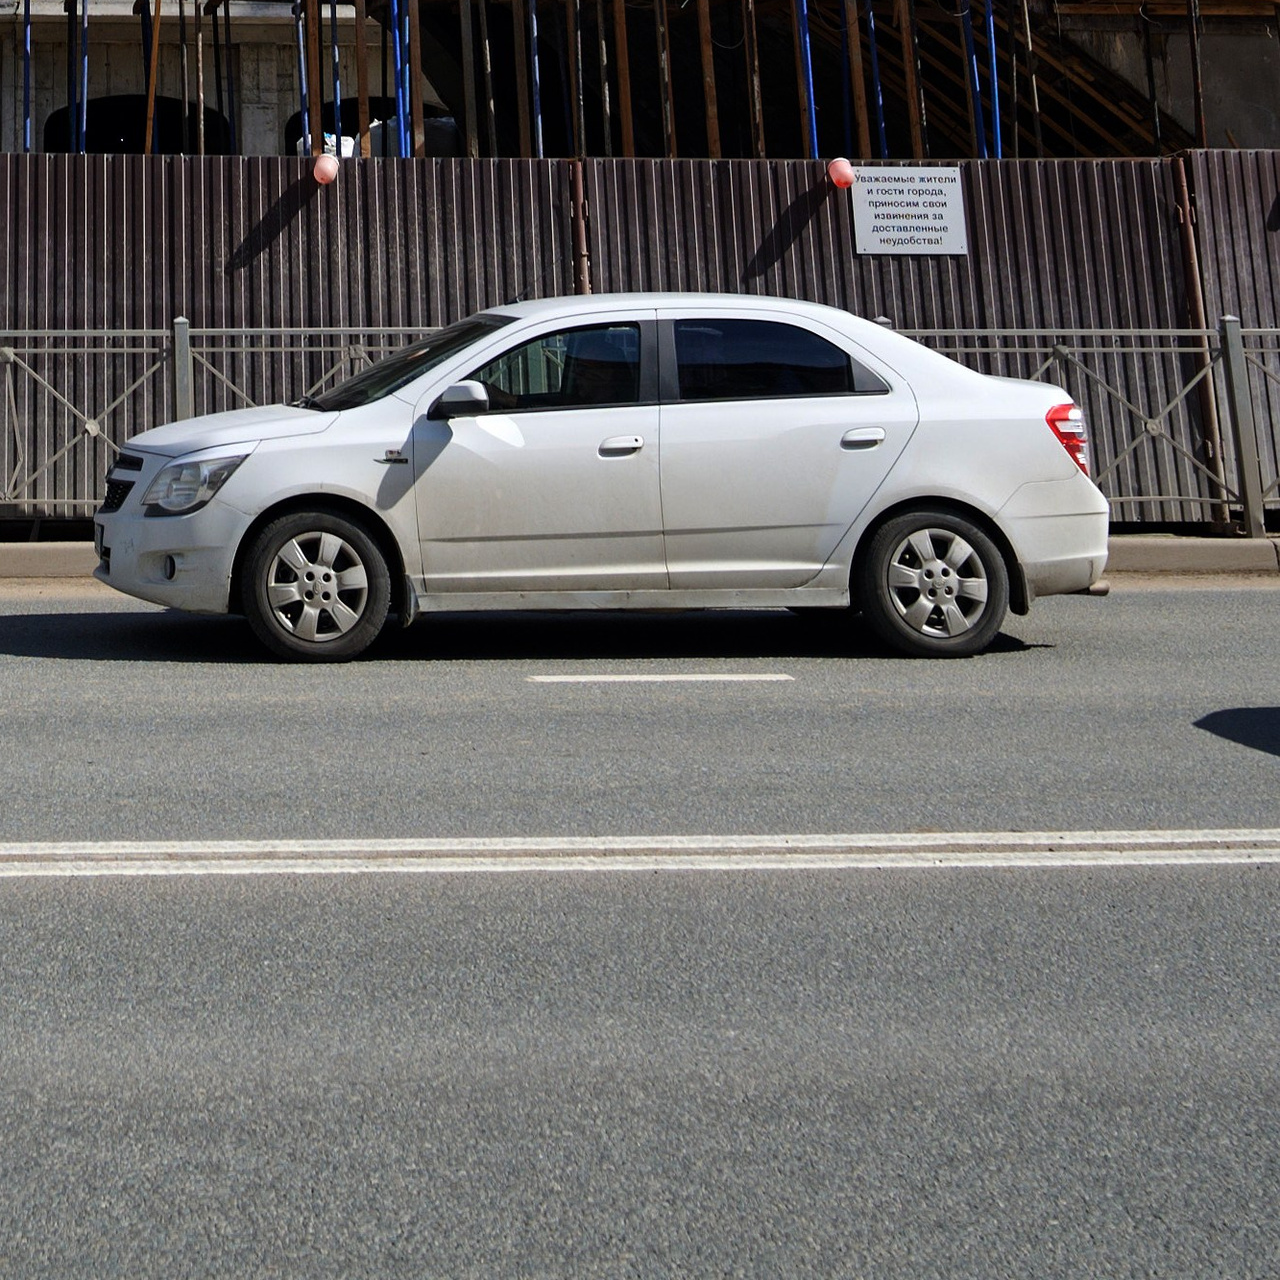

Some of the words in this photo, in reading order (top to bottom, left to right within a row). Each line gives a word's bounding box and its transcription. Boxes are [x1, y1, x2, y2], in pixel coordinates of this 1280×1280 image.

[854, 174, 916, 184] Уважаемые
[917, 175, 957, 184] жители
[907, 188, 947, 197] города,
[868, 201, 920, 209] приносим
[874, 212, 929, 220] извинения
[931, 212, 944, 220] за
[871, 224, 949, 233] доставленные
[879, 236, 943, 246] неудобства!
